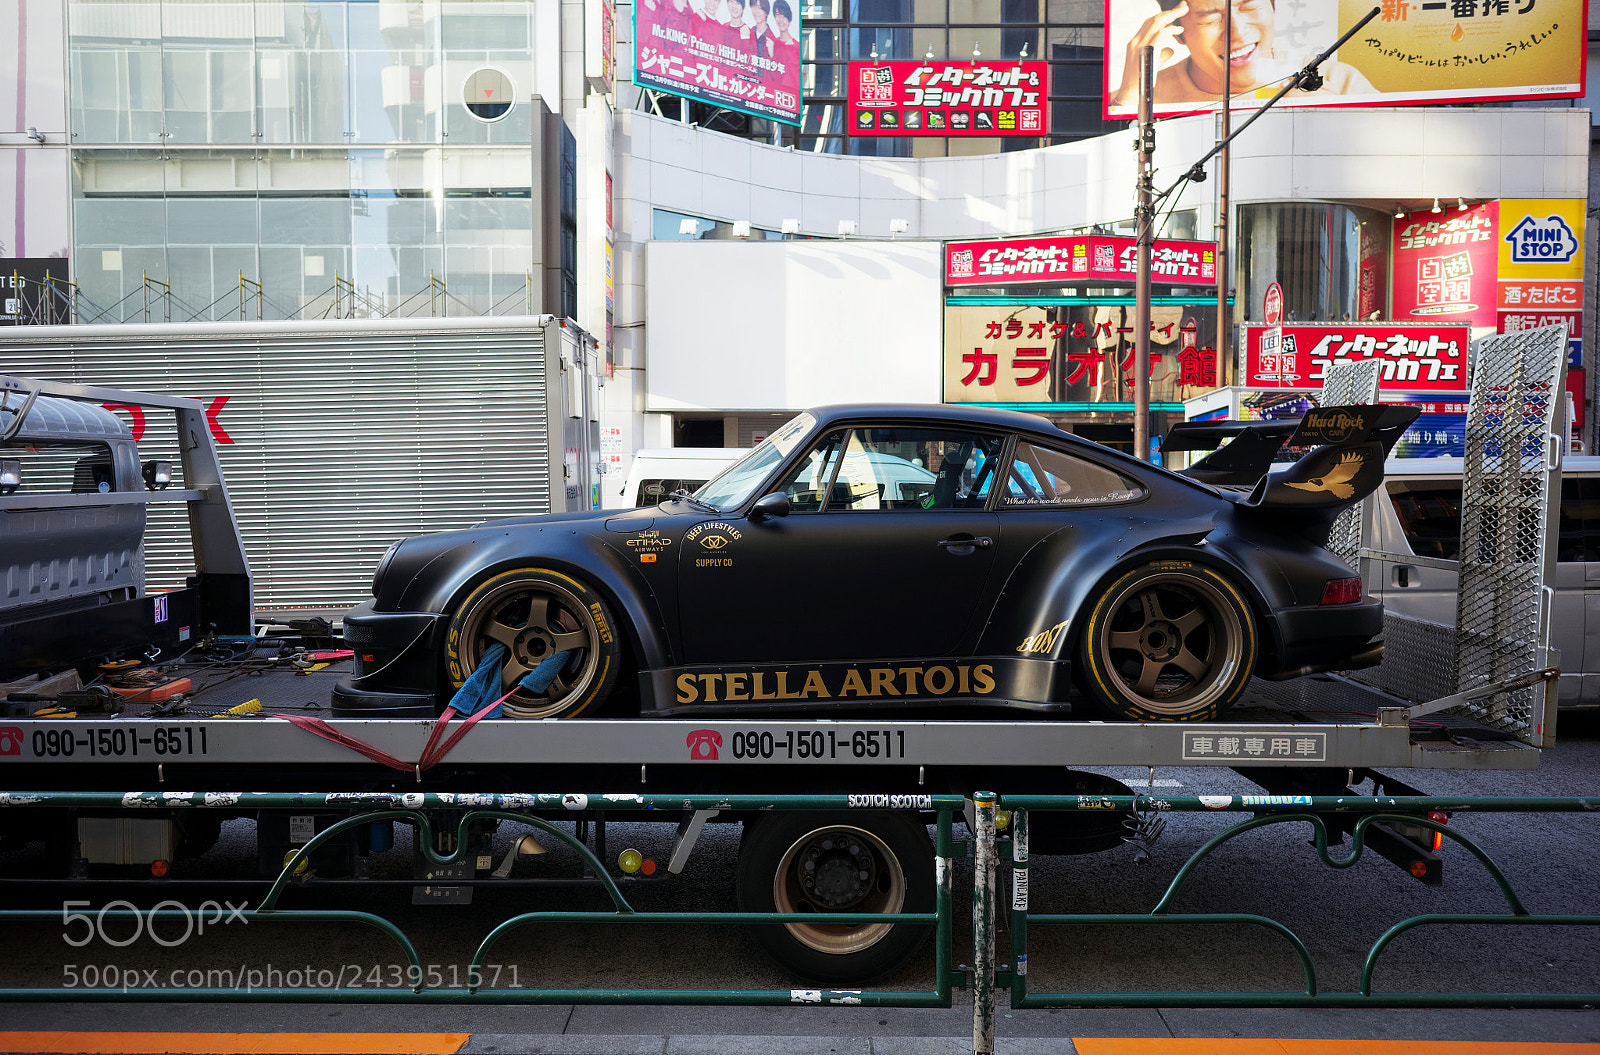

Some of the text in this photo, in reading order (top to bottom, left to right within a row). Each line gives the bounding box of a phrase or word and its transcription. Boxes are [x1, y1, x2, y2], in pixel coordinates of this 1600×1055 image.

[903, 66, 1040, 86] インターネット&
[774, 90, 796, 110] RED
[902, 87, 1040, 107] コミックカフェ
[999, 110, 1016, 120] 24
[1022, 111, 1039, 121] 3F
[1400, 214, 1492, 238] インターネット&
[1523, 228, 1562, 242] MINI
[1399, 228, 1492, 250] コミックカフェ
[979, 245, 1069, 262] インターネット&
[1120, 245, 1199, 263] イーネット&
[1520, 242, 1564, 257] STOP
[978, 258, 1069, 275] コミックカフェ
[1119, 259, 1199, 276] コクカフェ
[1422, 254, 1469, 279] 自遊
[1420, 281, 1469, 303] 空間
[1504, 286, 1577, 304] 酒・たばこ
[1309, 334, 1460, 357] インターネット&
[1308, 358, 1460, 381] コクカフェ
[1307, 413, 1365, 431] Hard Rock
[1004, 496, 1026, 505] What
[1027, 497, 1039, 505] the
[686, 522, 742, 541] DEEP LIFESTYLES
[626, 538, 672, 547] ETIHAD
[695, 558, 733, 568] SUPPLY CO
[676, 663, 997, 704] STELLA ARTOIS
[32, 726, 208, 757] 090-1501-6511
[732, 730, 906, 759] 090-1501-6511
[1191, 736, 1317, 756] 車載専用車
[847, 794, 932, 809] SCOTCH SCOTCH
[1013, 870, 1028, 909] PANCAKE
